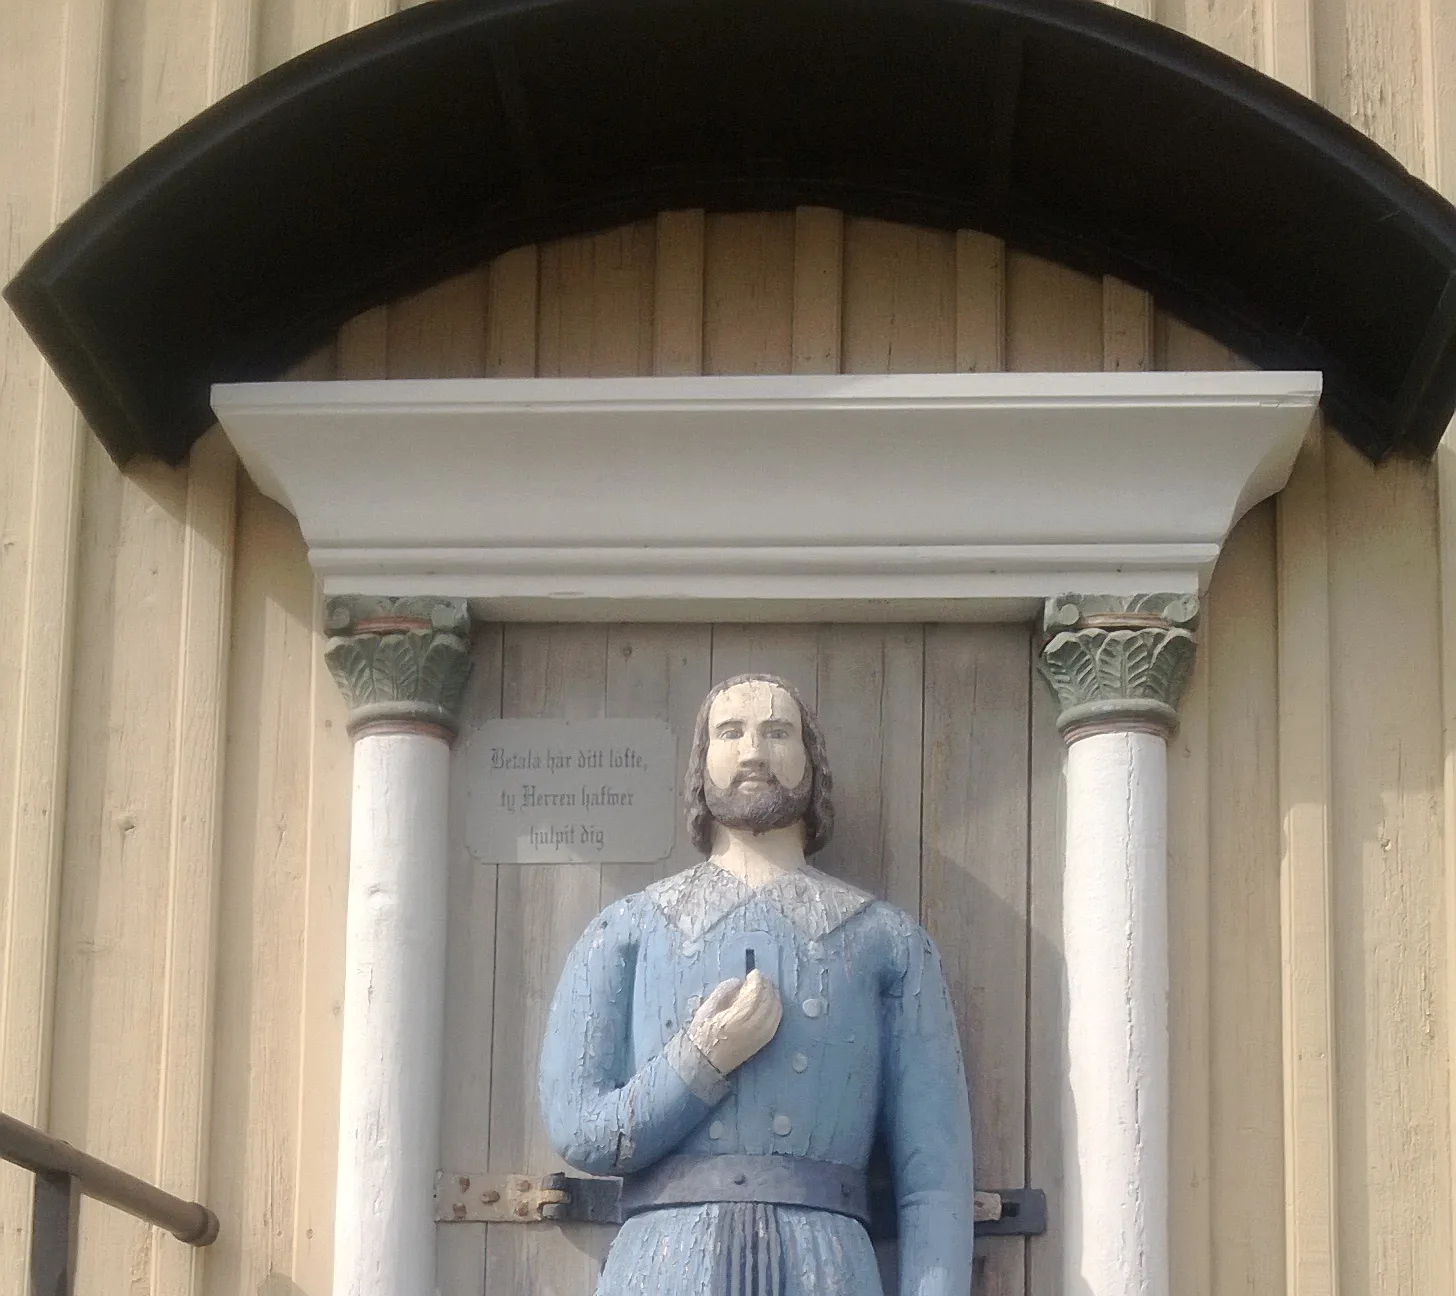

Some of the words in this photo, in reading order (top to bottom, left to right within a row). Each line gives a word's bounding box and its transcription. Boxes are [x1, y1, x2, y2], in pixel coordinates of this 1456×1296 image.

[490, 748, 541, 771] Betala
[577, 749, 603, 769] ditt
[500, 789, 515, 814] ty
[520, 785, 576, 812] Herren
[580, 824, 605, 851] dig
